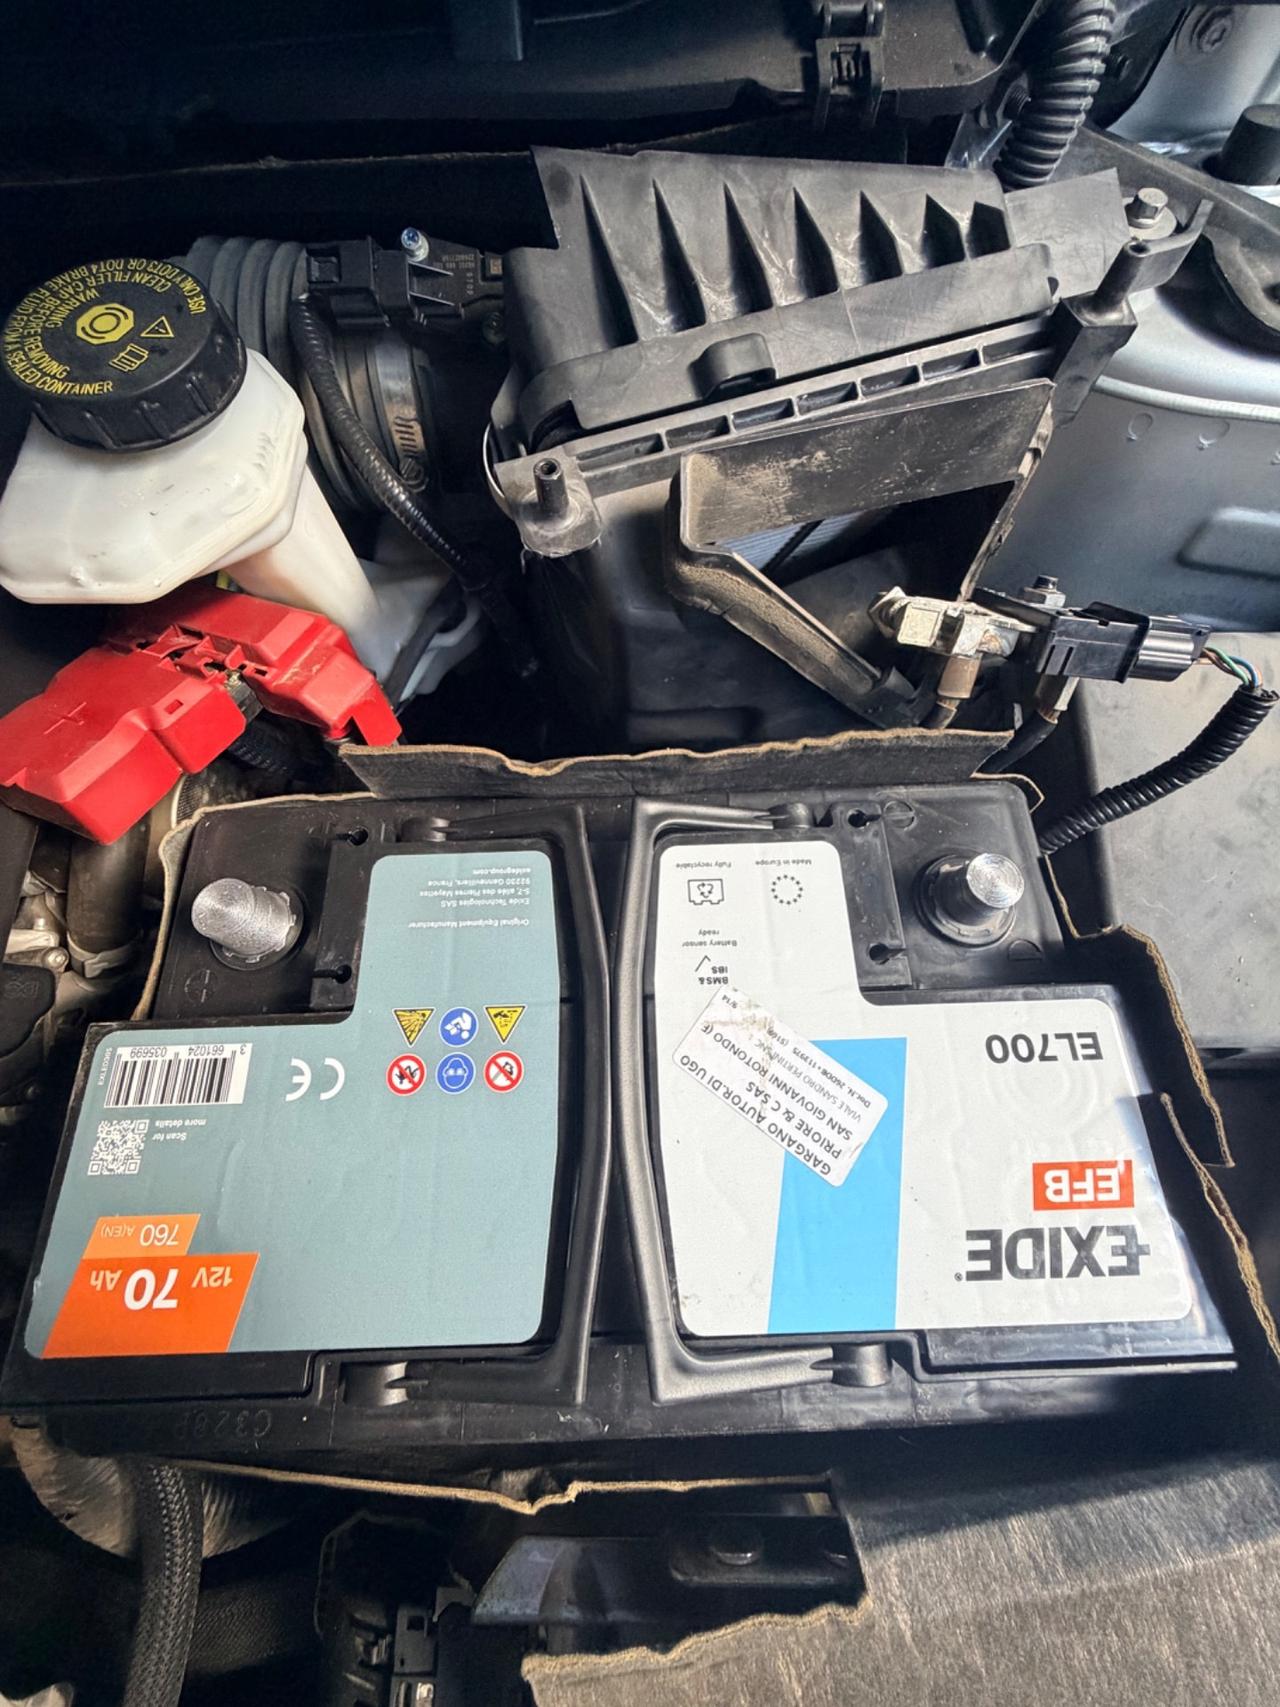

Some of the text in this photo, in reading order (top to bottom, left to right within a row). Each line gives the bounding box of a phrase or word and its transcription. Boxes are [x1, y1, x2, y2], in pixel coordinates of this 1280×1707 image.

[91, 259, 124, 274] DOT4
[127, 258, 147, 270] OR
[147, 260, 180, 279] DOT3
[44, 265, 89, 291] BRAKE
[175, 273, 201, 296] ONLY
[16, 287, 50, 315] FLUID
[45, 287, 100, 328] WARNING
[187, 294, 207, 315] USE
[4, 314, 28, 342] FROM
[24, 271, 172, 379] CLEAN FILLER CAP BEFORE REMOVING
[8, 350, 41, 384] SEALED
[36, 376, 113, 394] CONTAINER
[676, 861, 713, 869] recyclable
[441, 900, 458, 908] SAS
[459, 898, 507, 907] Technologies
[459, 919, 499, 928] Equipment
[500, 918, 529, 927] Original
[710, 939, 738, 947] Battery
[711, 966, 728, 975] IBS
[130, 1045, 247, 1059] 3 661024 035699
[713, 1032, 769, 1078] ROTONDO
[986, 1032, 1103, 1064] EL700
[680, 1055, 707, 1081] UGO
[768, 1073, 827, 1121] GIOVANNI
[802, 1075, 839, 1105] SANDRO
[745, 1081, 842, 1160] PRIORE & C SAS
[837, 1101, 862, 1123] VIALE
[155, 1119, 207, 1129] more details
[826, 1116, 854, 1141] SAN
[152, 1132, 187, 1142] Scan for
[767, 1122, 832, 1176] GARGANO
[1044, 1167, 1122, 1203] EFB
[101, 1223, 180, 1247] 760 A(EN)
[89, 1266, 234, 1311] 12V 70 Ah
